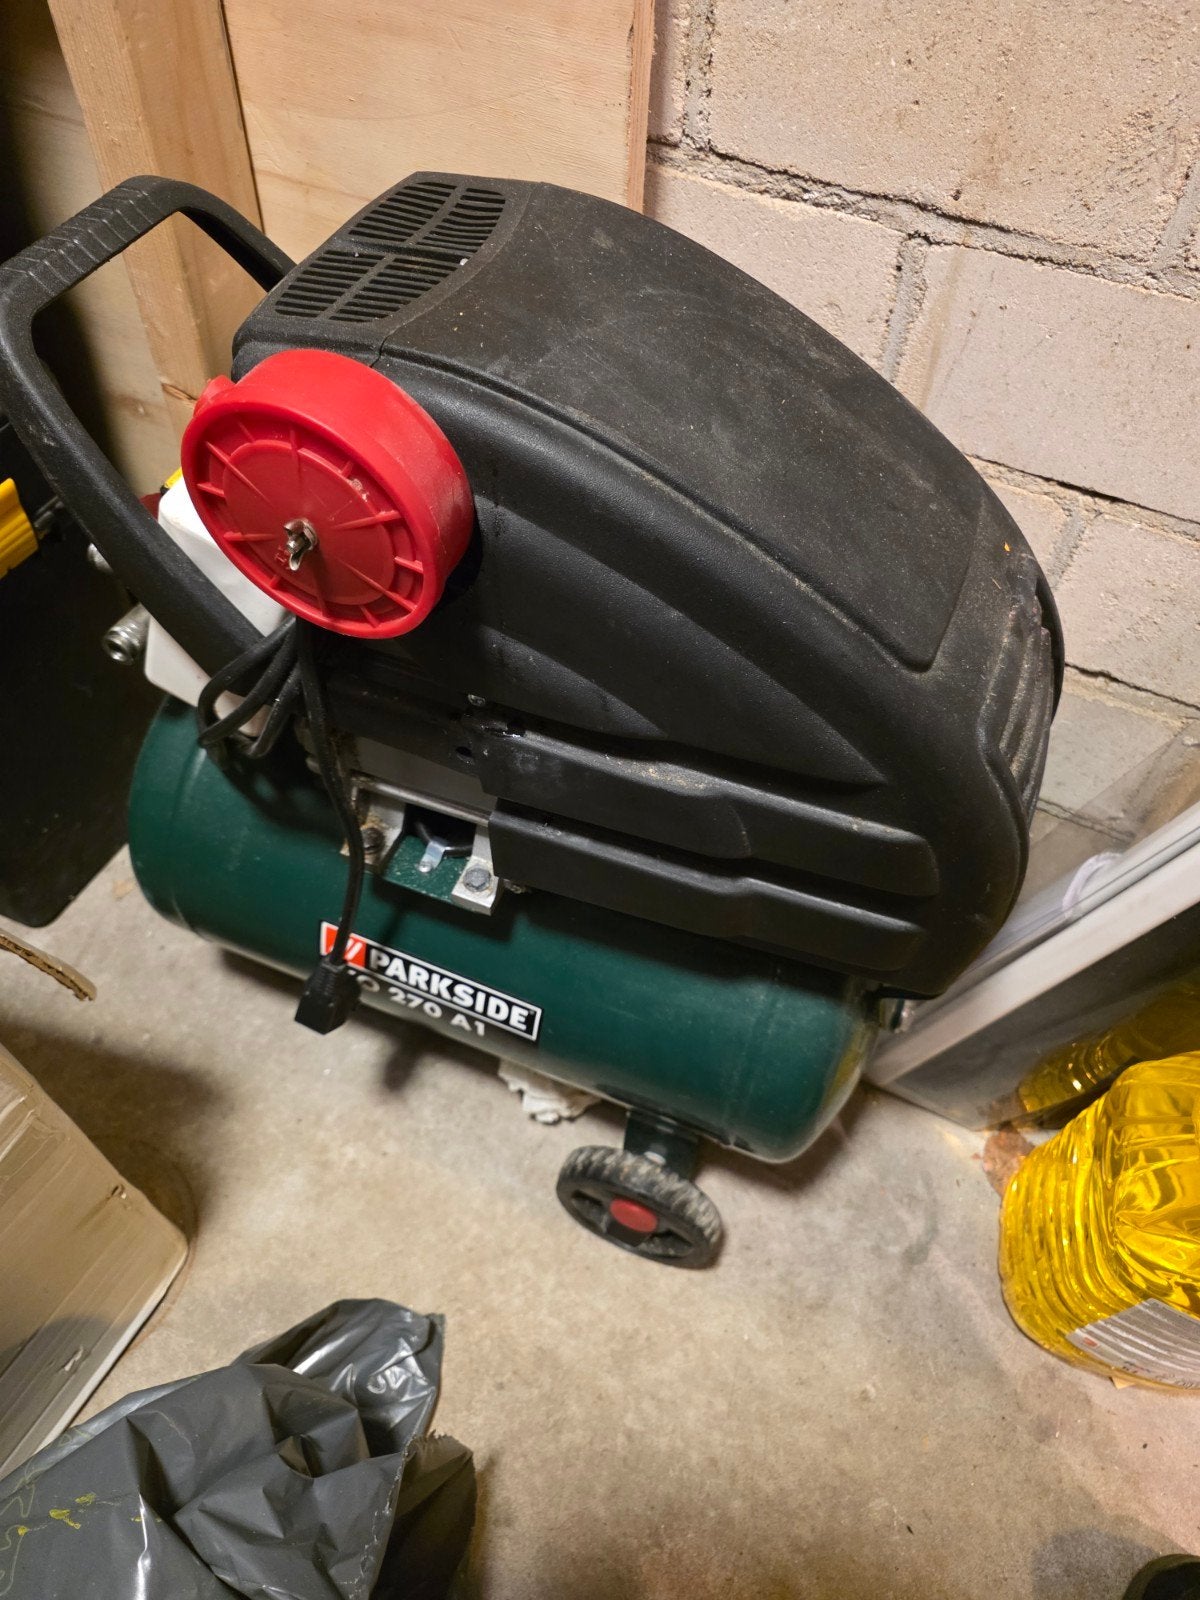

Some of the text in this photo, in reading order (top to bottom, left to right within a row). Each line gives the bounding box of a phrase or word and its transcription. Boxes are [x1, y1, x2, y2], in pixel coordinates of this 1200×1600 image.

[370, 948, 529, 1030] PARKSIDE
[388, 986, 442, 1018] 270
[450, 1013, 485, 1037] A1
